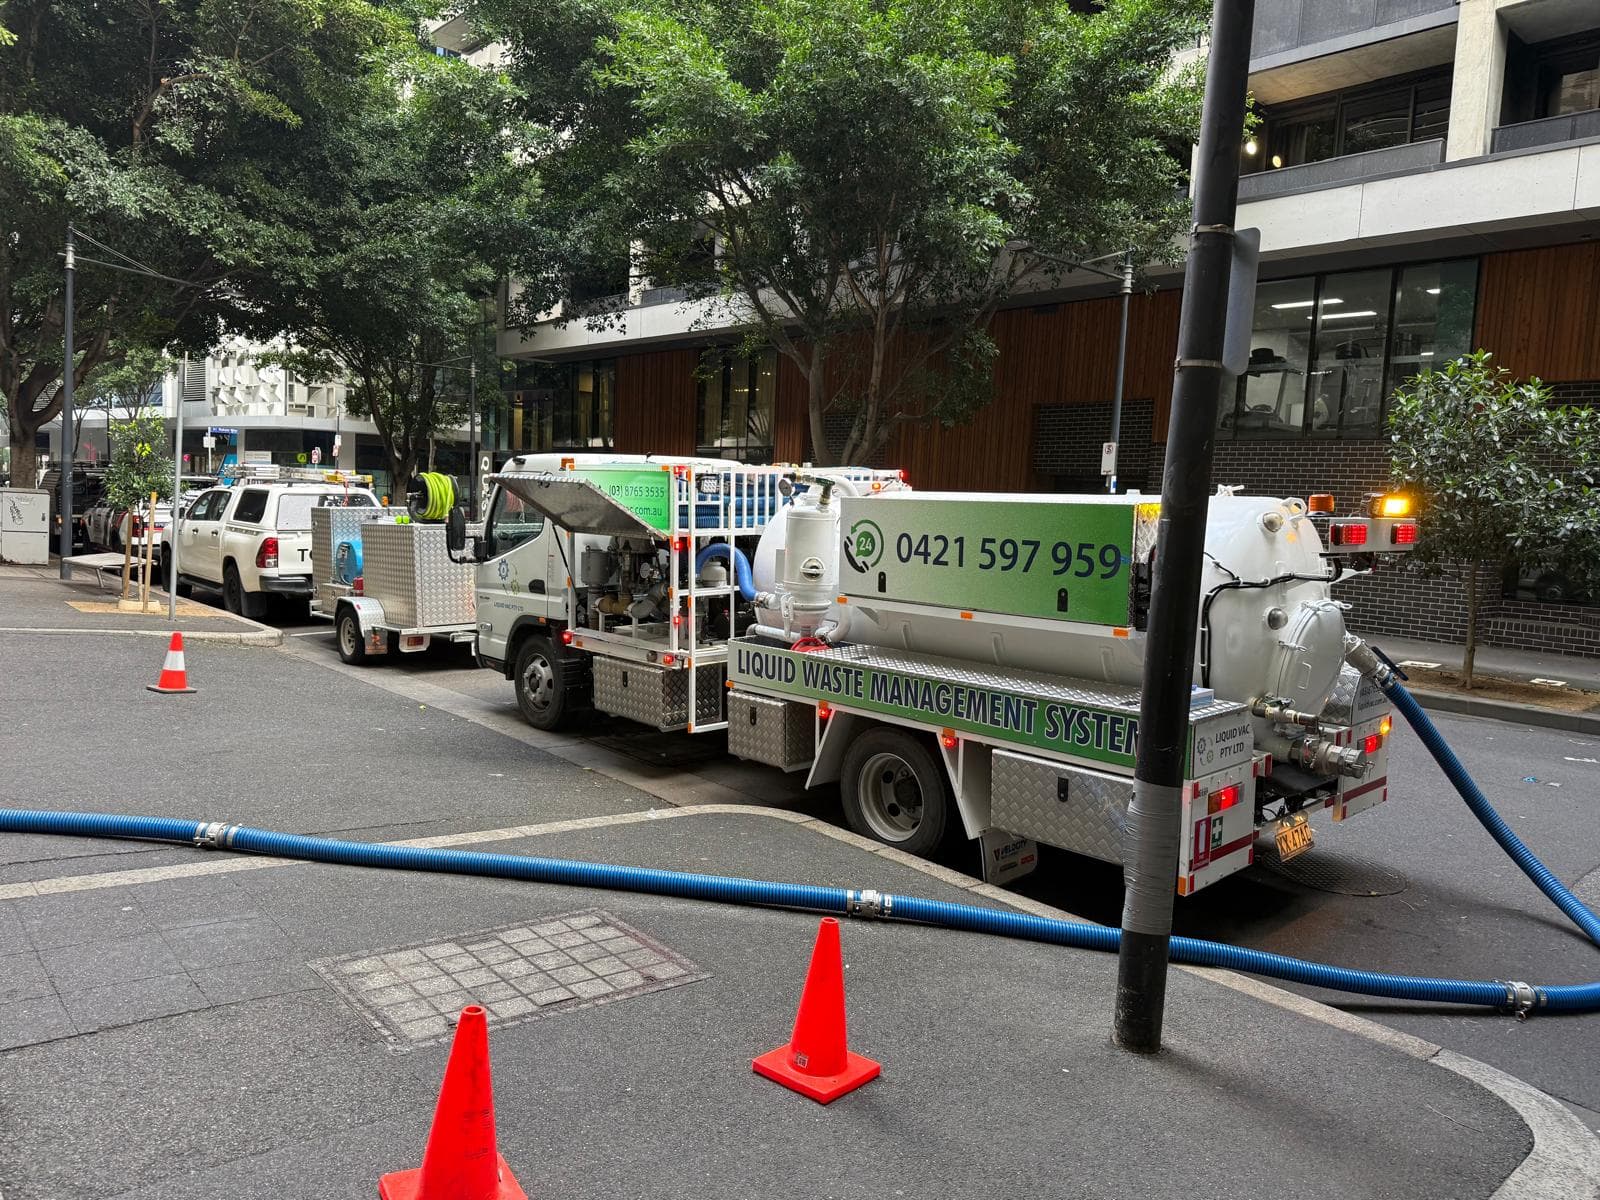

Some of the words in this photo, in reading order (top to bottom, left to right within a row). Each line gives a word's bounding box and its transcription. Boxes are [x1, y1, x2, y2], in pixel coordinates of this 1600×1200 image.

[609, 485, 623, 497] (03)
[624, 485, 643, 497] 8765
[645, 486, 665, 498] 3535
[859, 537, 873, 551] 24
[896, 532, 966, 568] 0421
[979, 537, 1041, 573] 597
[1051, 540, 1121, 580] 959
[737, 649, 796, 684] LIQUID
[801, 659, 864, 698] WASTE
[870, 673, 1038, 734] MANAGEMENT
[1215, 728, 1237, 743] LIQUID
[1237, 724, 1249, 736] VAC
[1221, 745, 1232, 757] PTY
[1232, 742, 1244, 754] LTD
